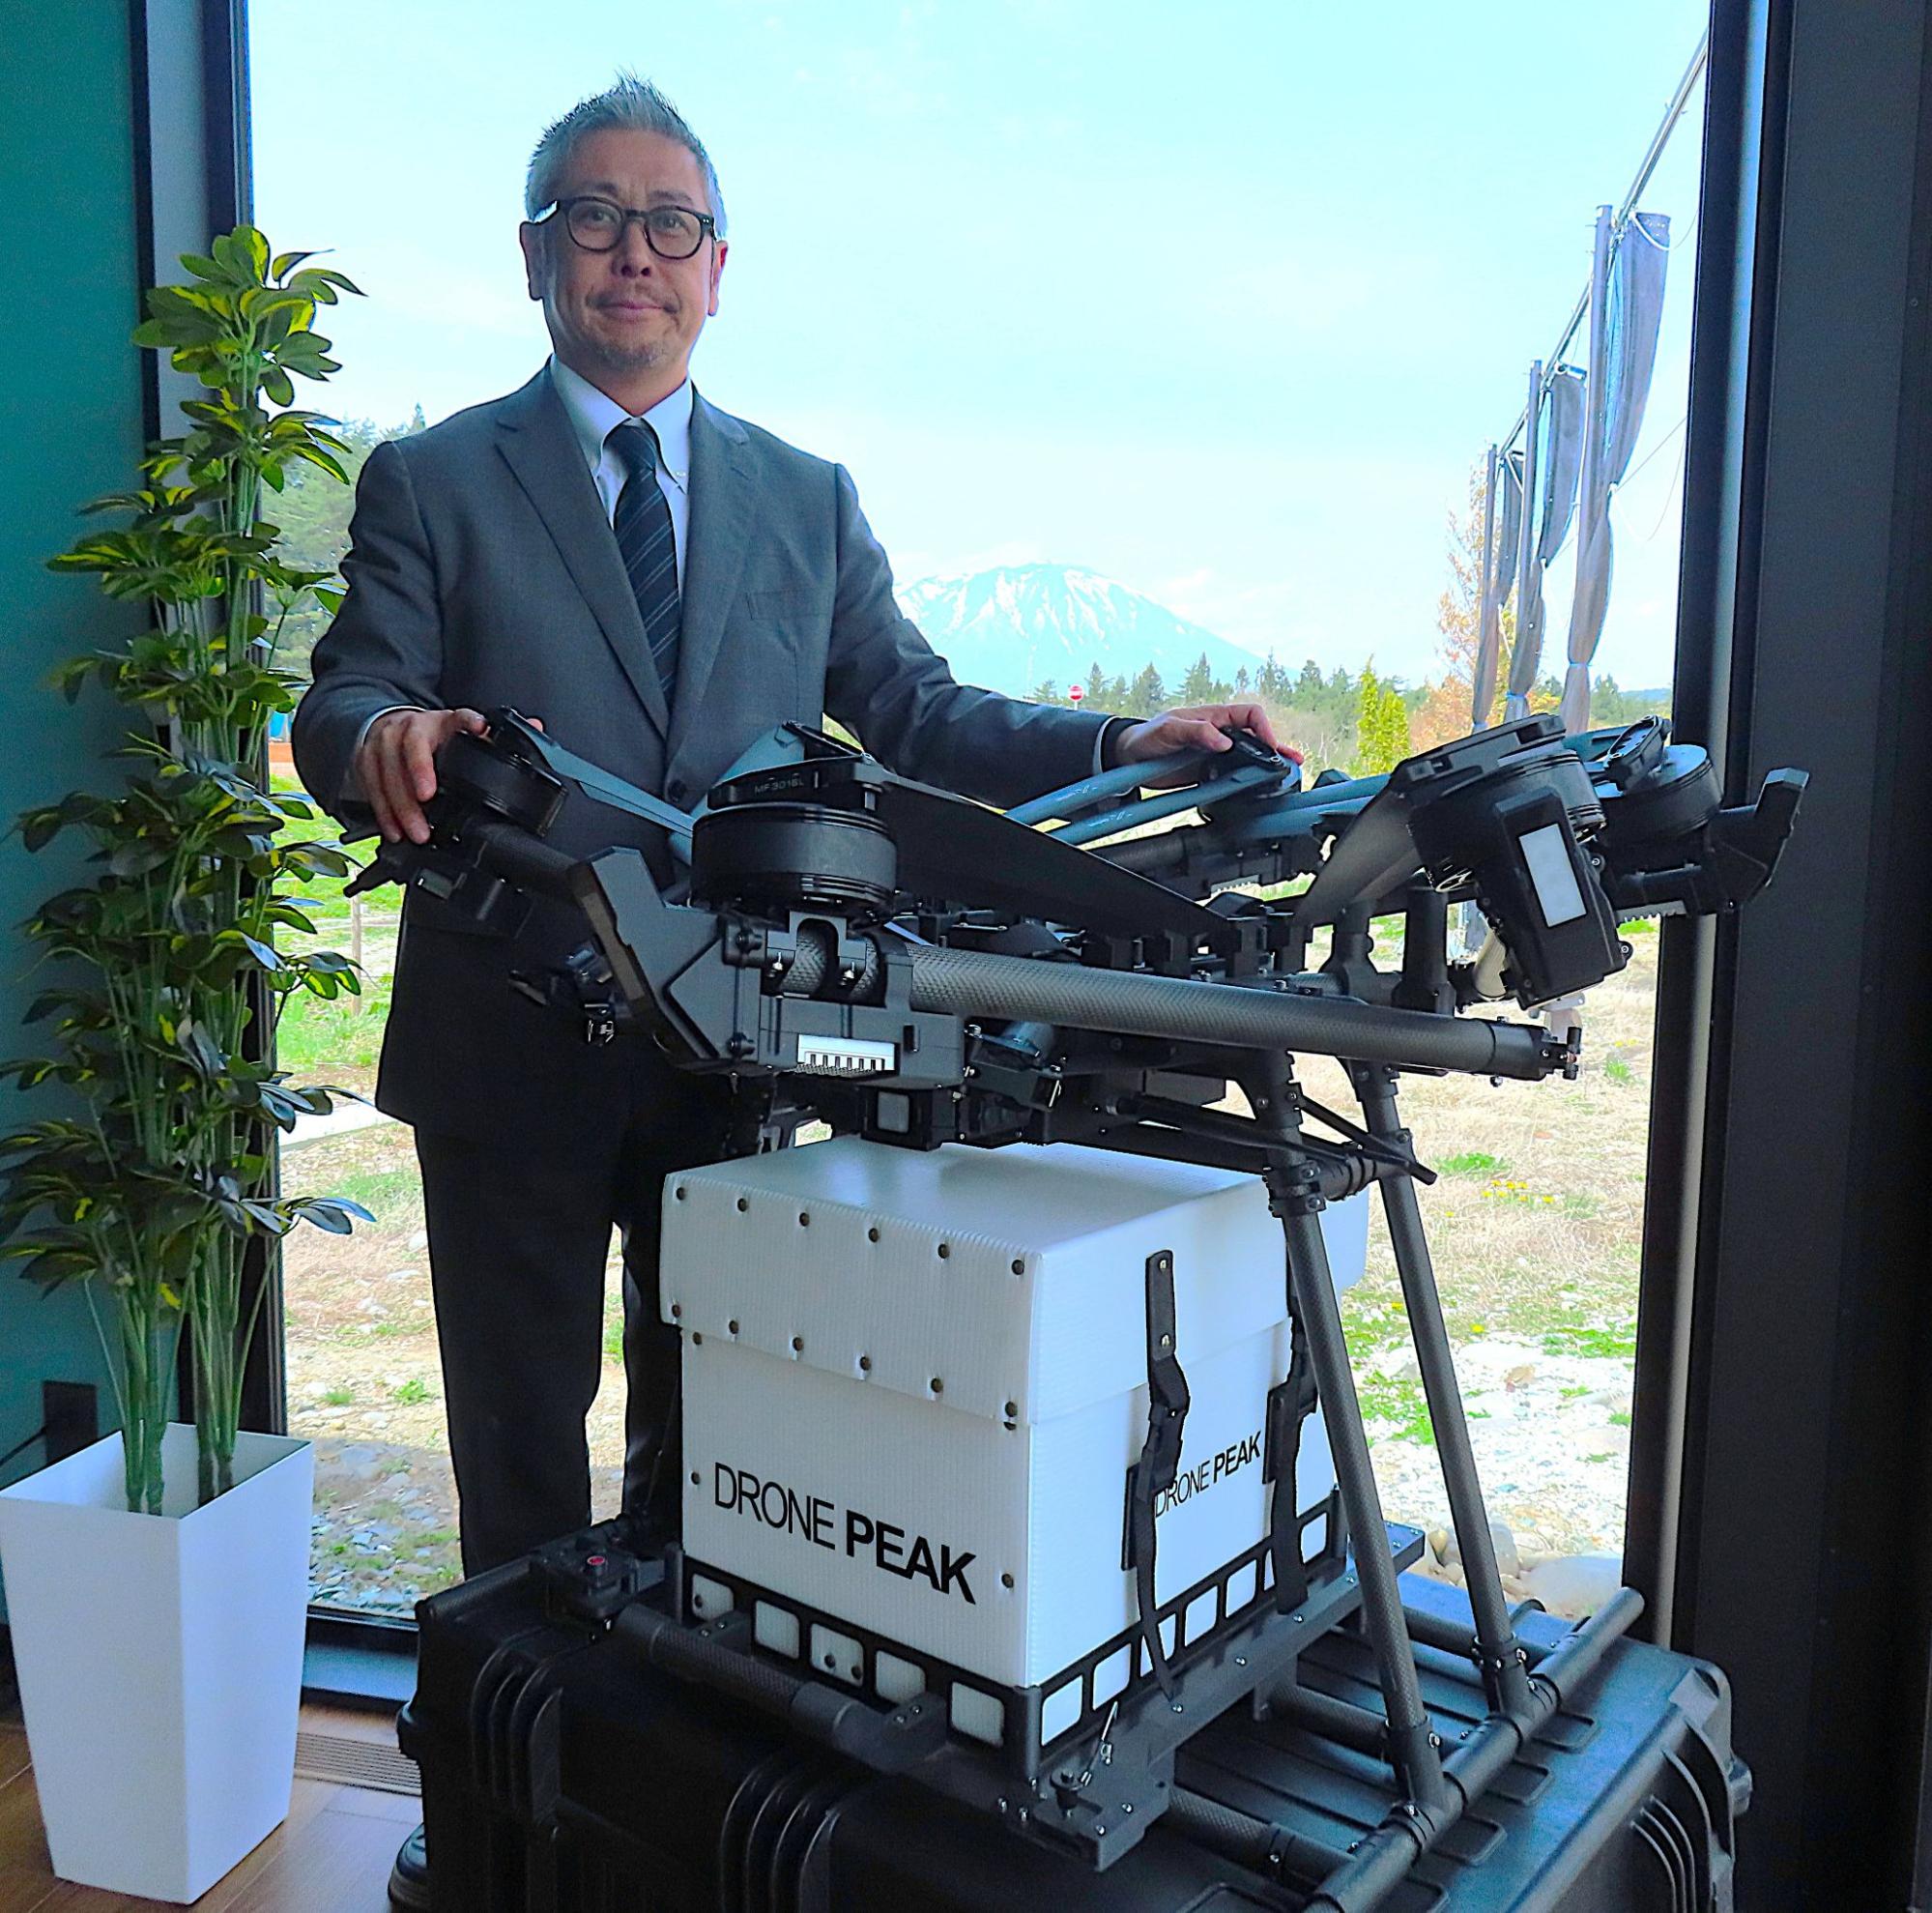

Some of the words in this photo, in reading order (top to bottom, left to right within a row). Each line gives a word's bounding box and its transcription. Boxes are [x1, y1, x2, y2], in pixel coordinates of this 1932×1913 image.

[1155, 1461, 1210, 1518] DRONE
[1214, 1431, 1261, 1484] PEAK
[715, 1462, 835, 1551] DRONE
[847, 1509, 976, 1605] PEAK
